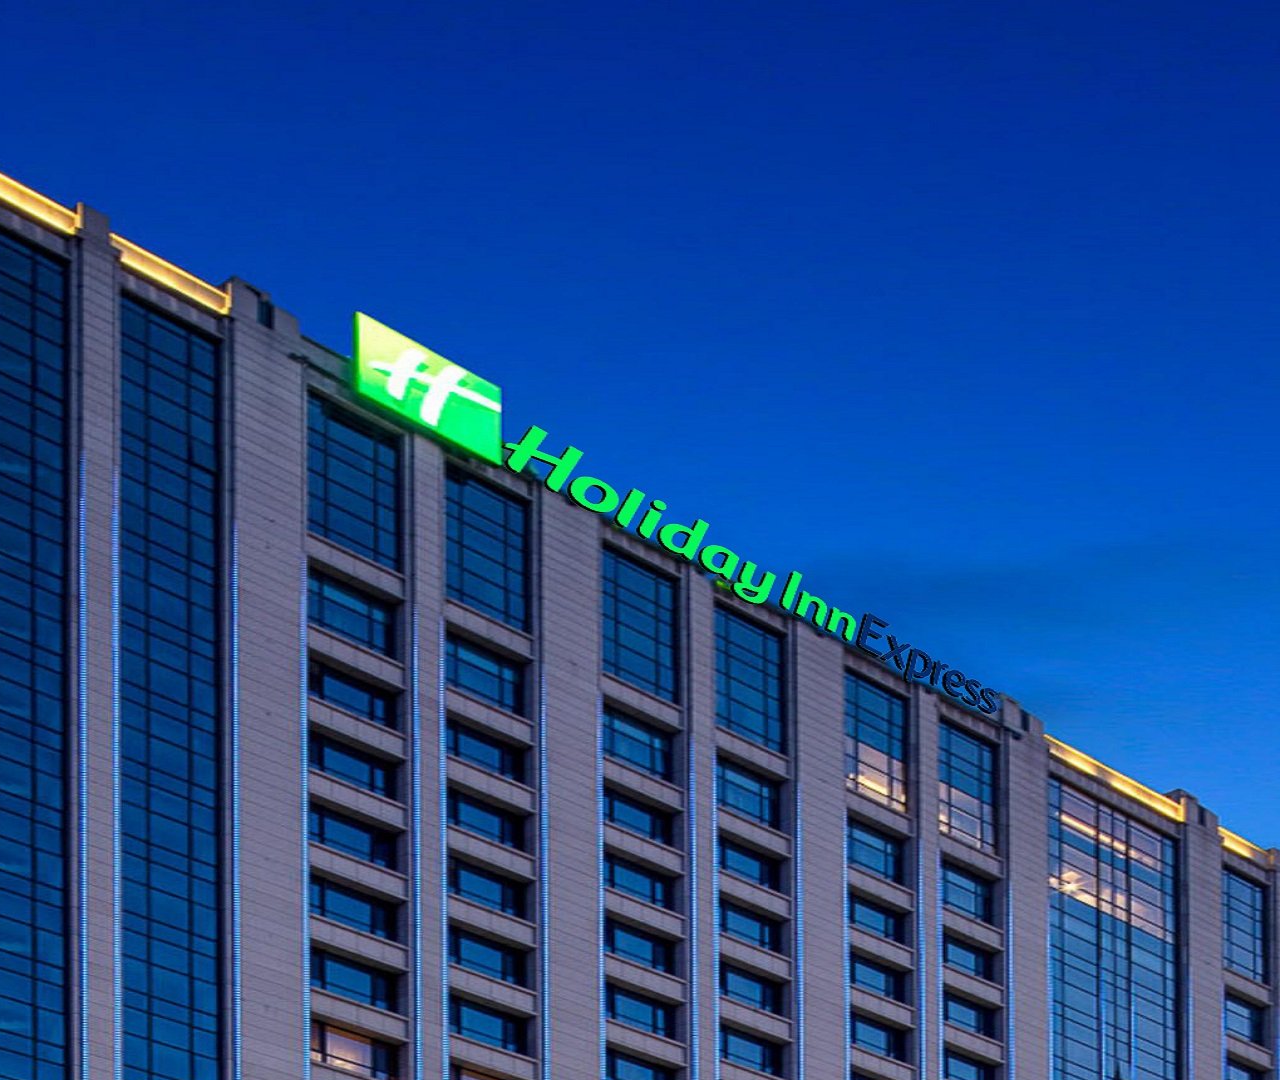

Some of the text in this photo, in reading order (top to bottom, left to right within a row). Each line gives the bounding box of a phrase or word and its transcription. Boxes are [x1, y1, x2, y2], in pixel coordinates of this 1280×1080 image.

[503, 424, 1000, 714] Holiday Inn Express
